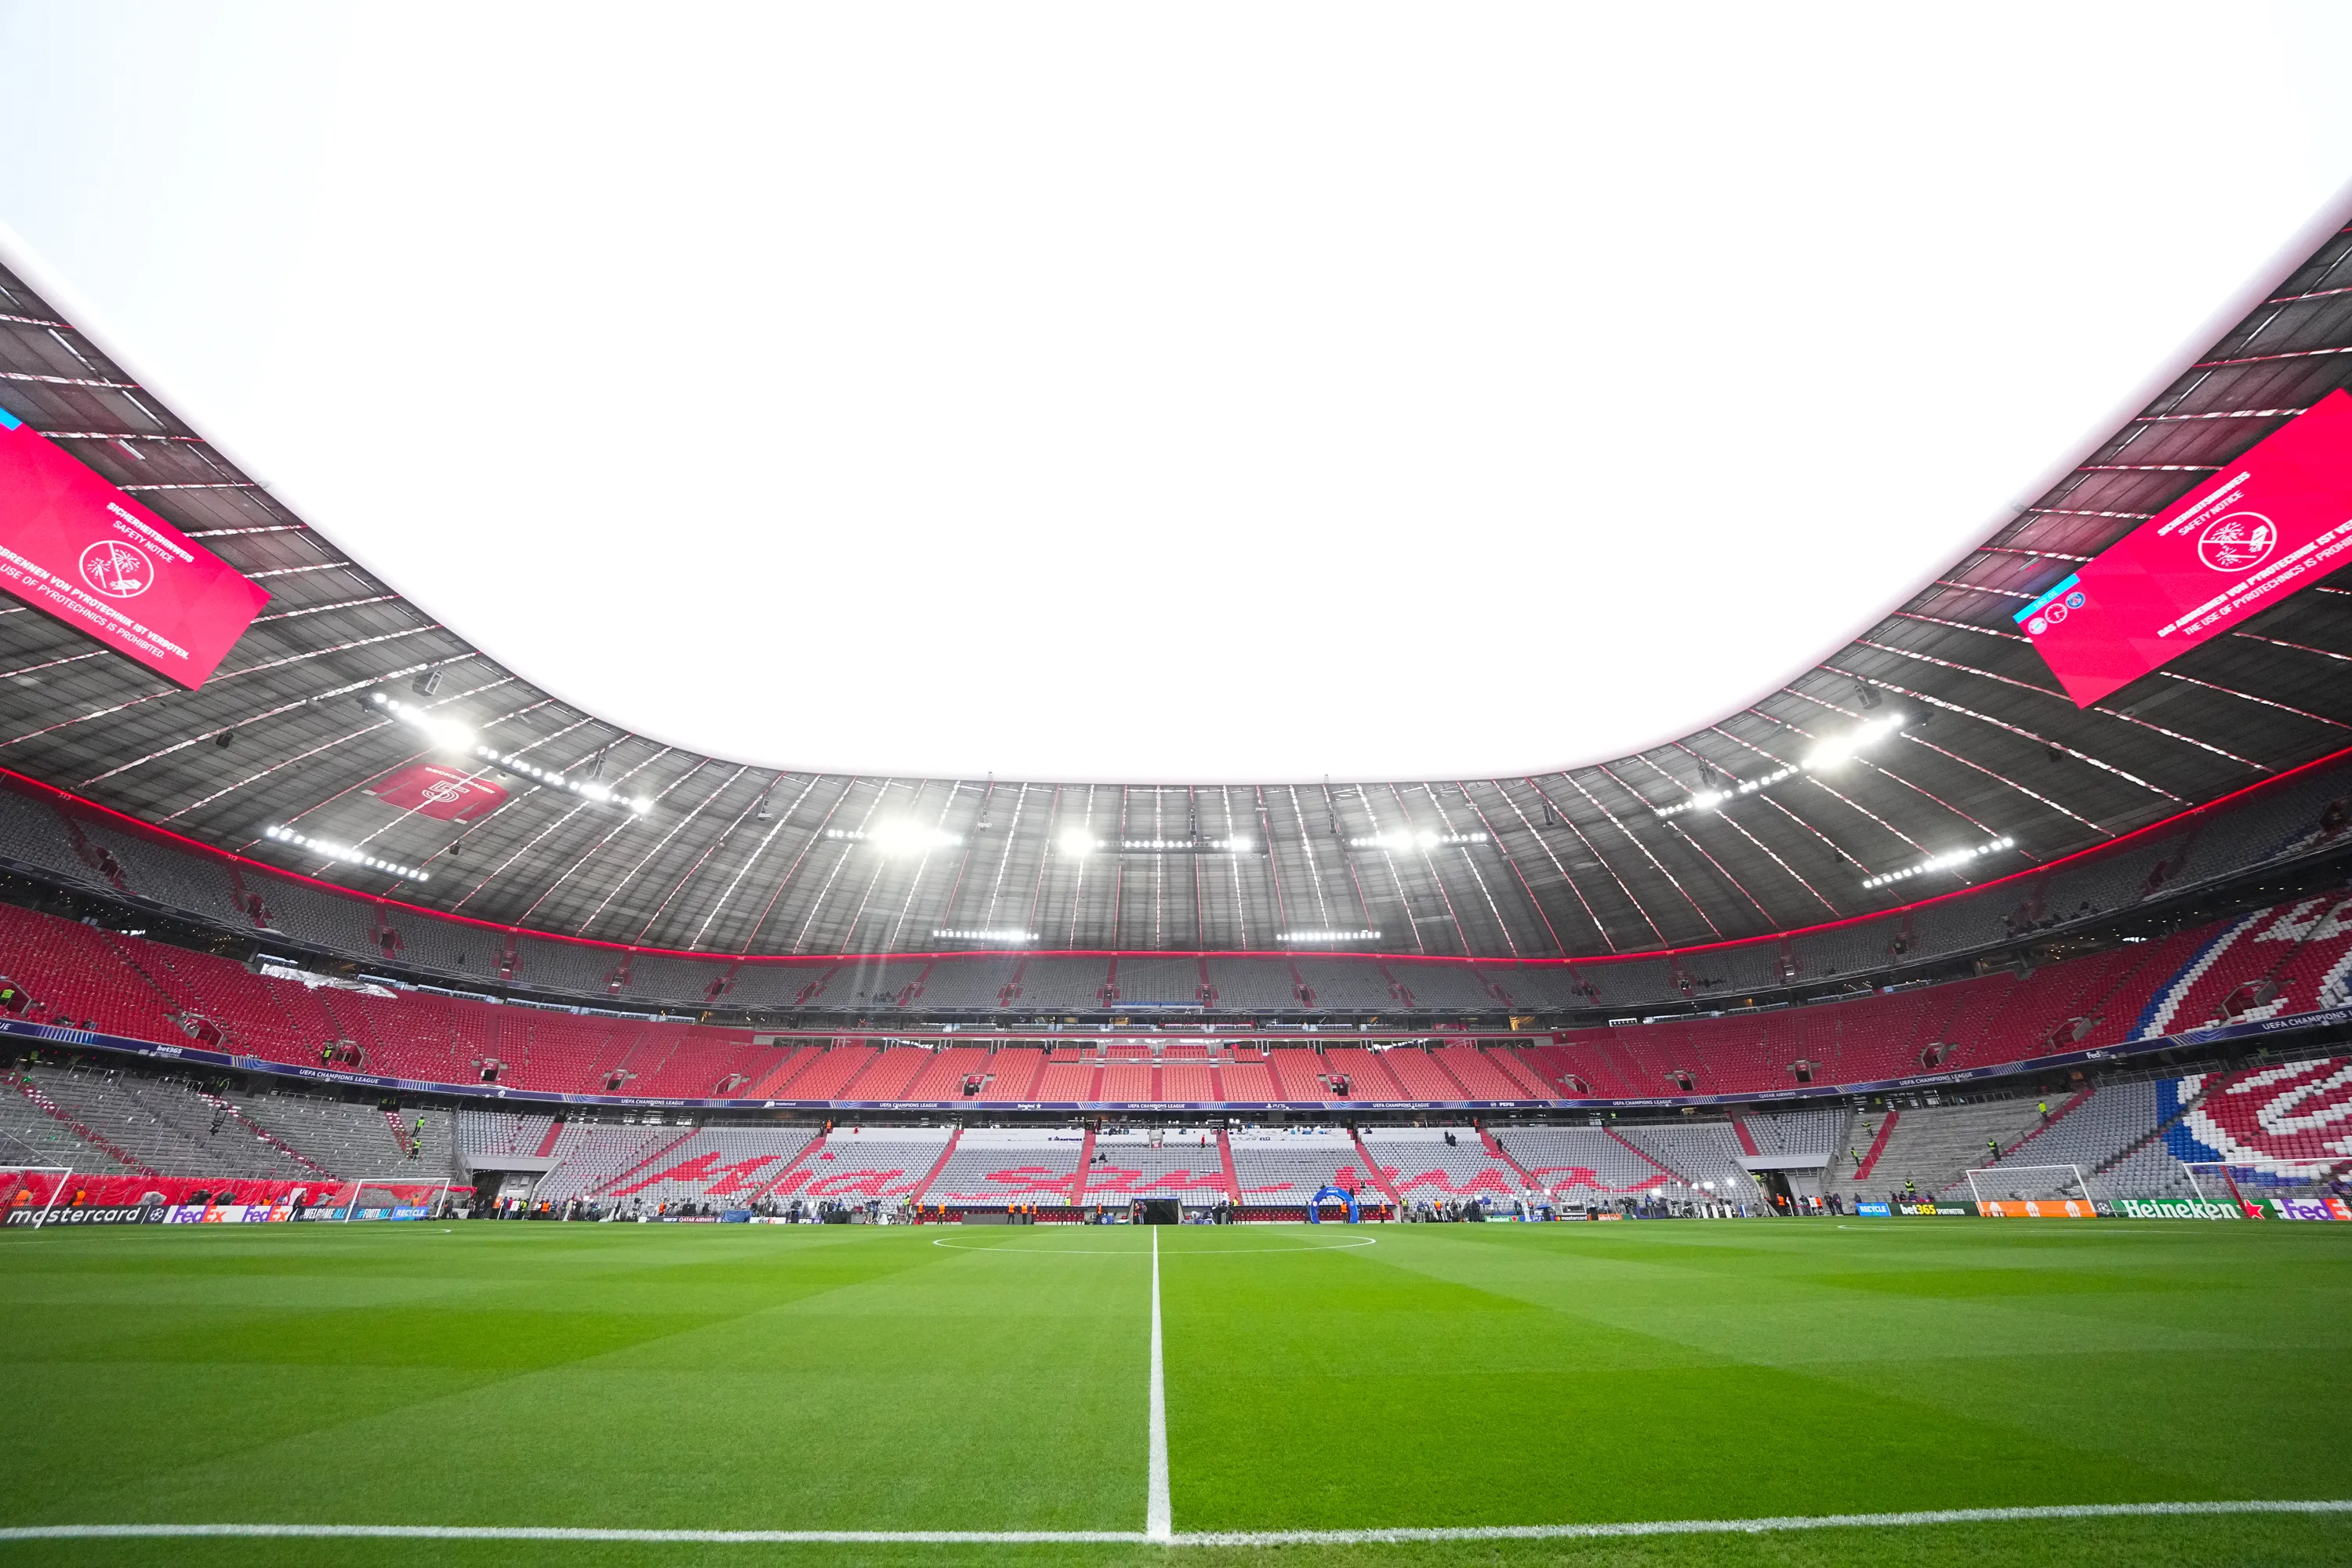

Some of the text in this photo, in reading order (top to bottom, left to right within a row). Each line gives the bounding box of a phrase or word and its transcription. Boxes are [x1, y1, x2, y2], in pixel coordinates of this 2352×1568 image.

[2178, 490, 2245, 535] SAFETY NOTICE
[107, 502, 194, 563] SICHERHEITSHINWEIS
[113, 520, 175, 564] SAFETY NOTICE
[2157, 622, 2177, 638] DAS
[2227, 581, 2249, 597] VON
[2315, 530, 2336, 546] IST
[2183, 623, 2202, 636] THE
[2201, 612, 2222, 626] USE
[2220, 605, 2234, 616] OF
[2231, 564, 2306, 608] PYROTECHNICS
[2303, 557, 2318, 568] IS
[0, 564, 165, 659] USE OF PYROTECHNICS IS PROHIBITED.
[49, 575, 73, 592] VON
[71, 588, 134, 627] PYROTECHNIK
[132, 622, 149, 635] IST
[147, 630, 189, 659] VERBOTEN.
[422, 780, 470, 803] 5
[2262, 1020, 2288, 1029] UEFA
[2288, 1011, 2347, 1025] CHAMPIONS
[157, 1044, 183, 1054] bet365
[317, 1071, 354, 1081] CHAMPIONS
[1915, 1074, 1950, 1084] CHAMPIONS
[6, 1207, 142, 1224] mastercard
[171, 1205, 227, 1223] FedEx
[241, 1205, 291, 1222] FedEx
[303, 1208, 347, 1219] WELCOME ALL
[357, 1208, 391, 1219] #FOOTBALL
[1900, 1204, 1936, 1214] bet365
[2121, 1200, 2241, 1219] Heineken
